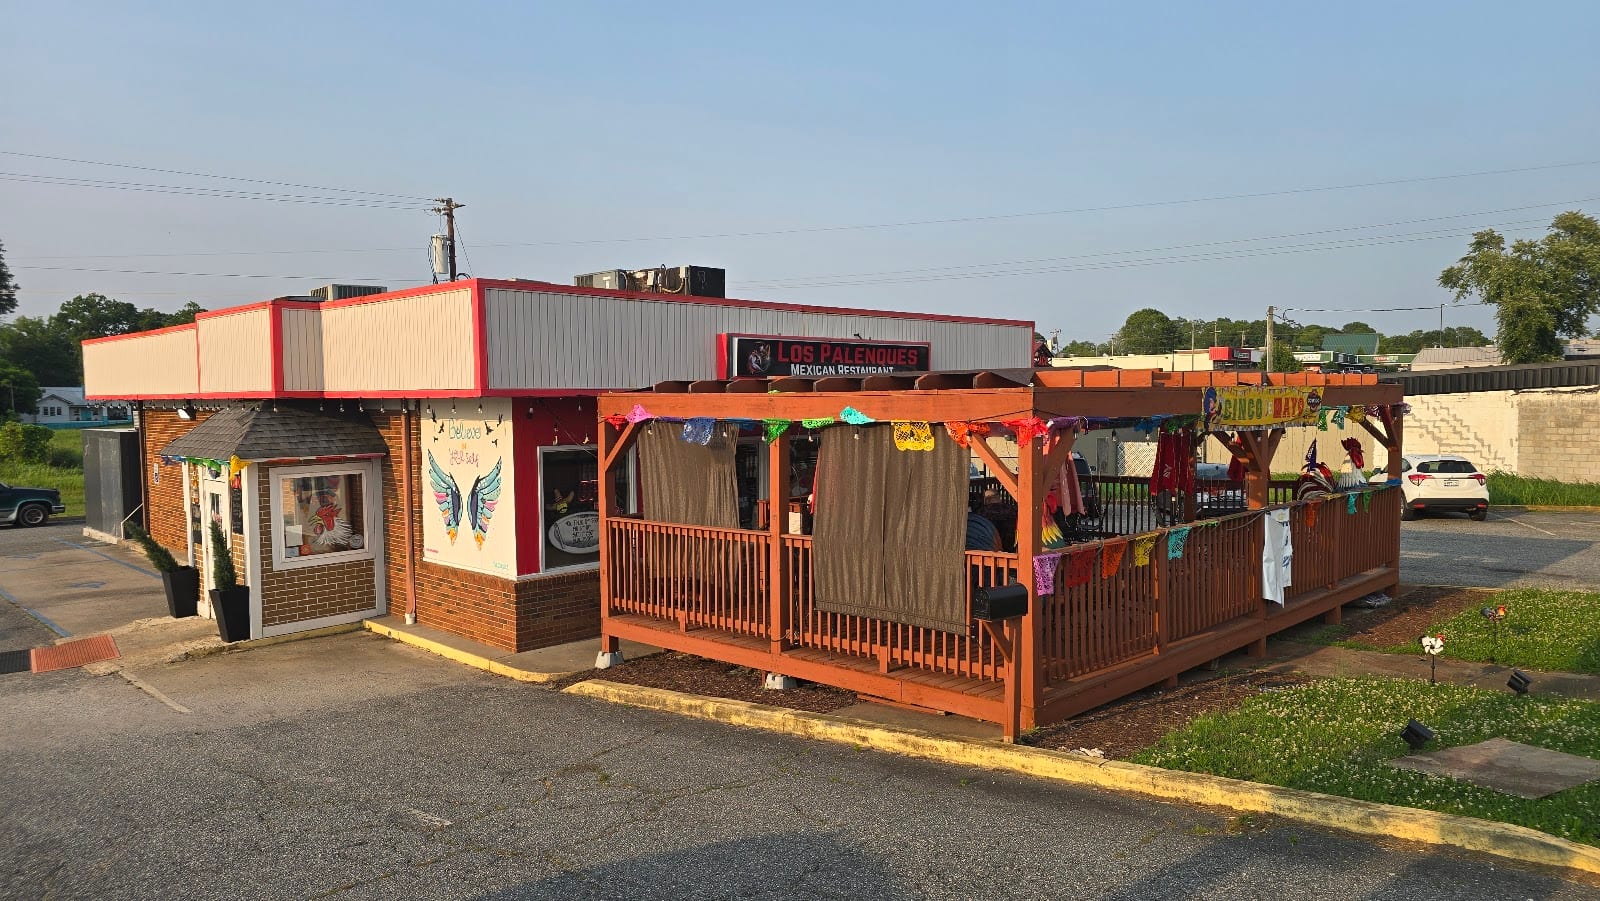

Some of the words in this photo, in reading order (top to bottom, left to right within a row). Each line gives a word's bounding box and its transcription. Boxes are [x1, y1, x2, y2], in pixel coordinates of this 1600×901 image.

[778, 342, 814, 363] LOS
[820, 344, 918, 365] PALENQUES
[791, 364, 836, 376] MEXICAN
[838, 364, 894, 375] RESTAURANT
[1223, 399, 1262, 421] CINCO
[1273, 397, 1304, 418] MAYO
[449, 418, 481, 439] Believe
